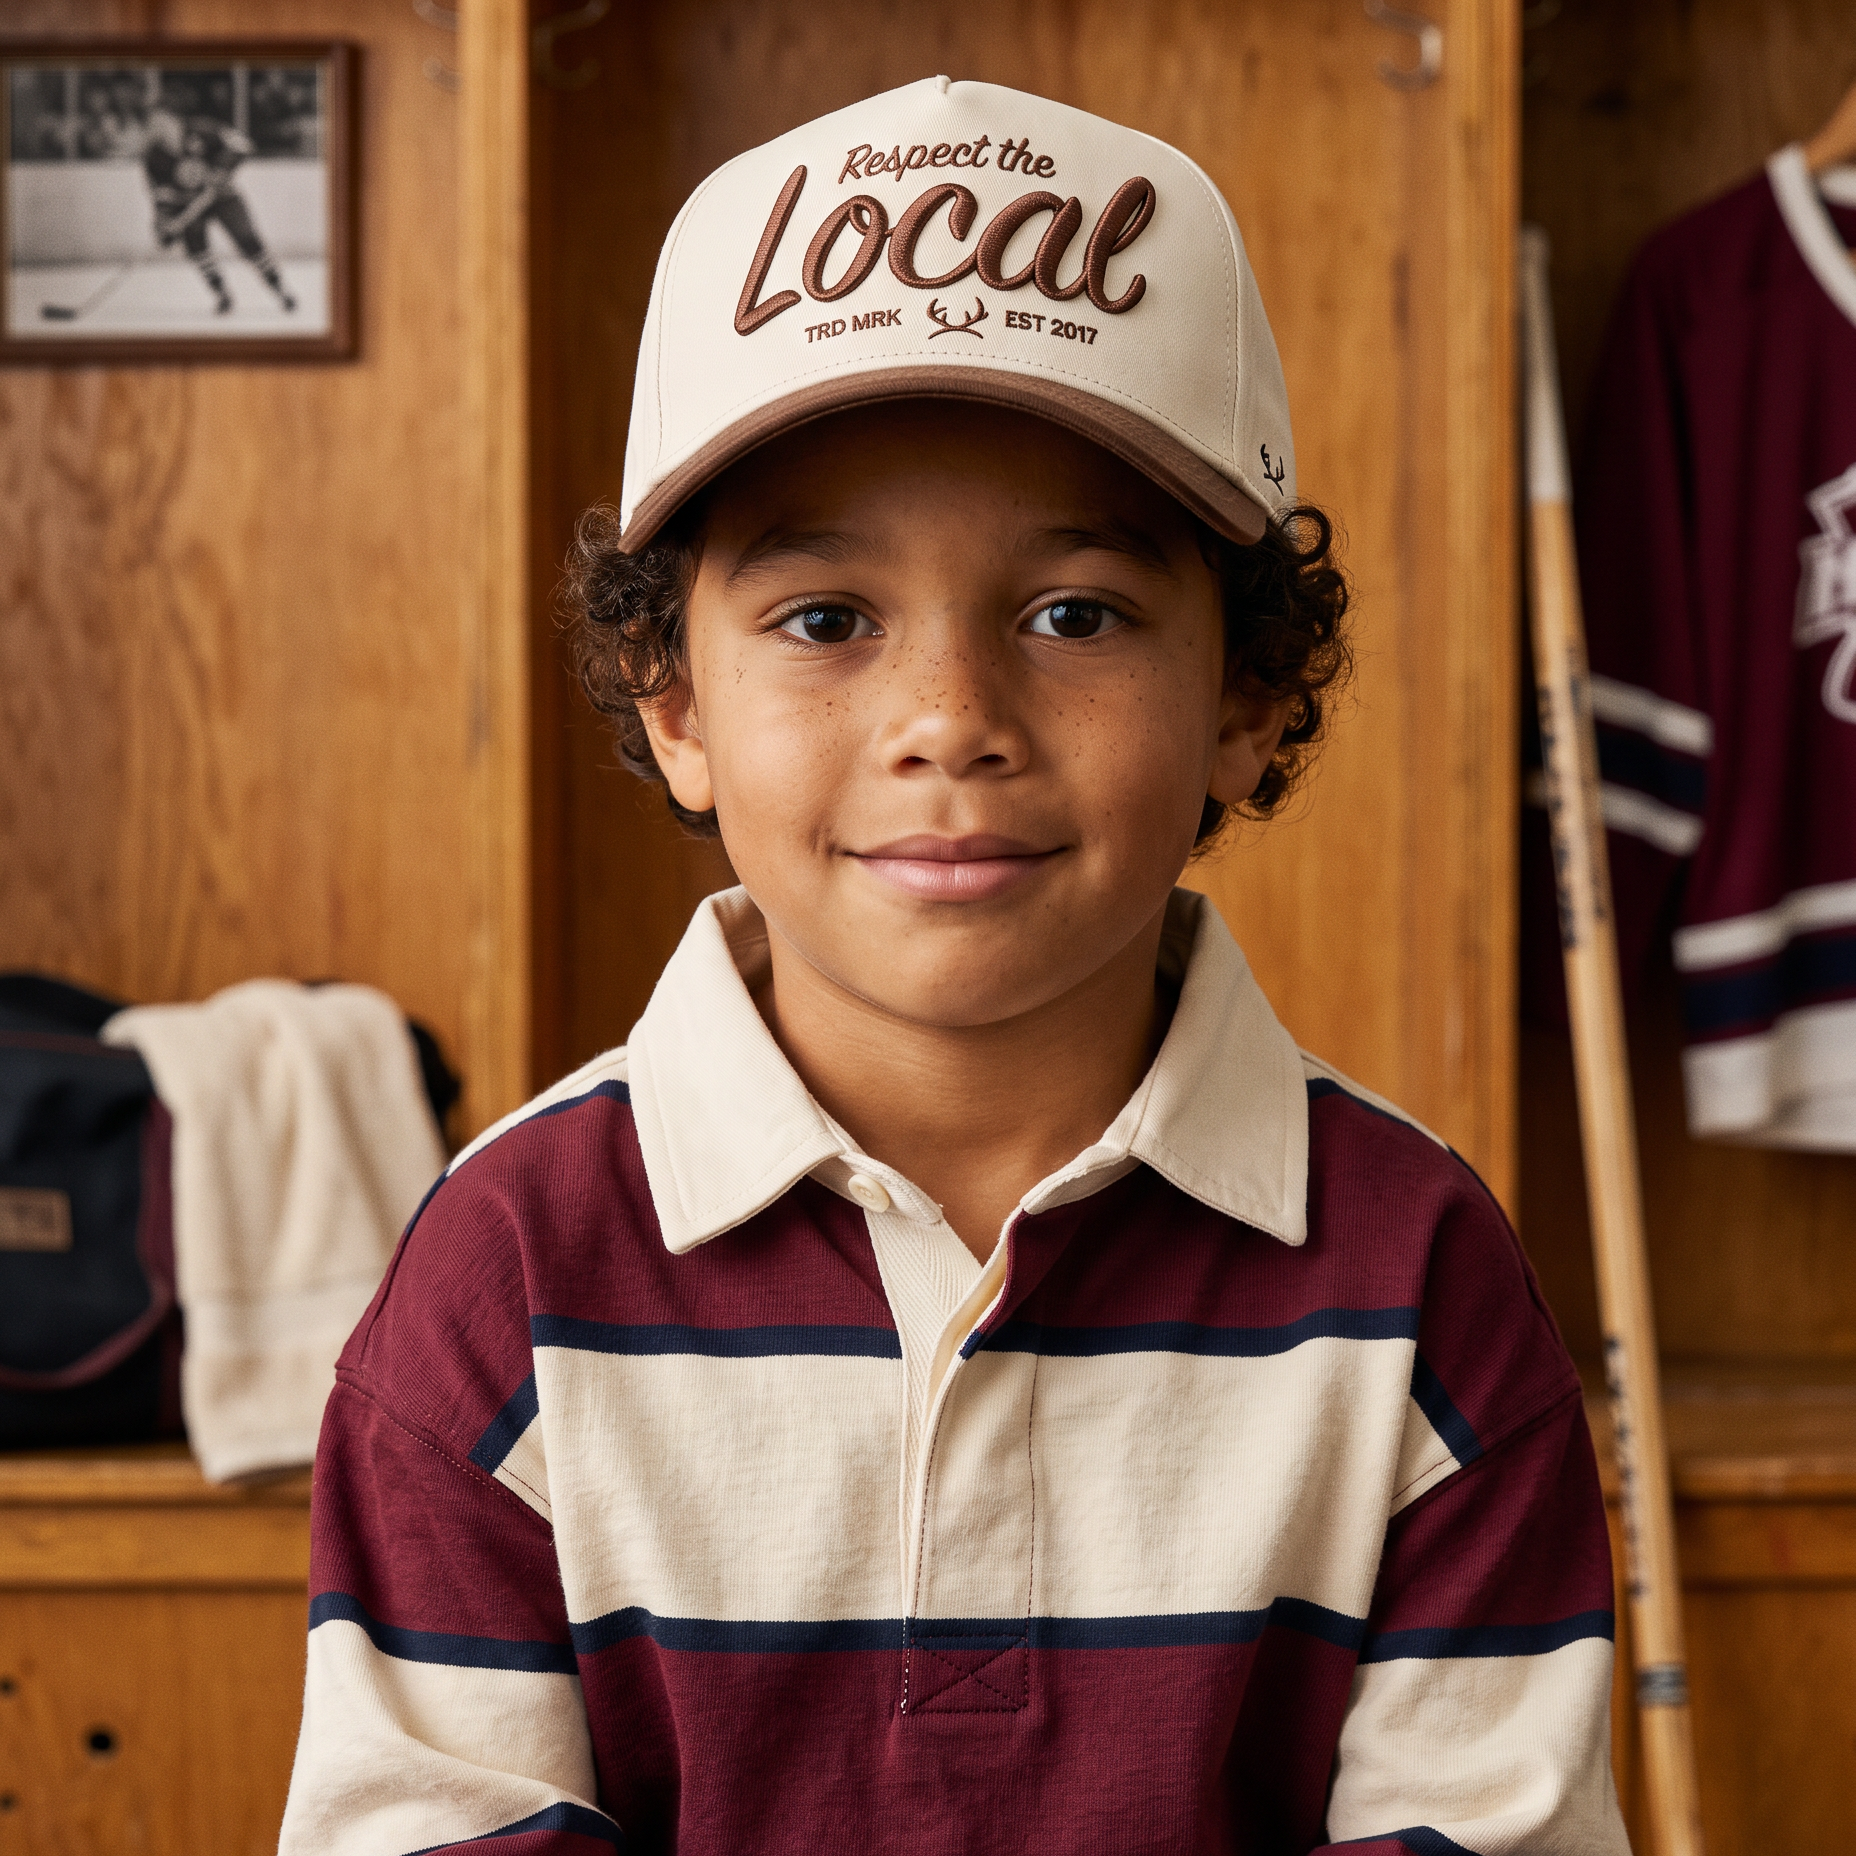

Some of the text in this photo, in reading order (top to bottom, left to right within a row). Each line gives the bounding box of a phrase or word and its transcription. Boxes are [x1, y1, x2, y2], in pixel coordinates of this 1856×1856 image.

[838, 134, 1057, 184] Respect the
[734, 164, 1157, 337] Local
[805, 308, 1099, 345] TRD MRK EST 2017
